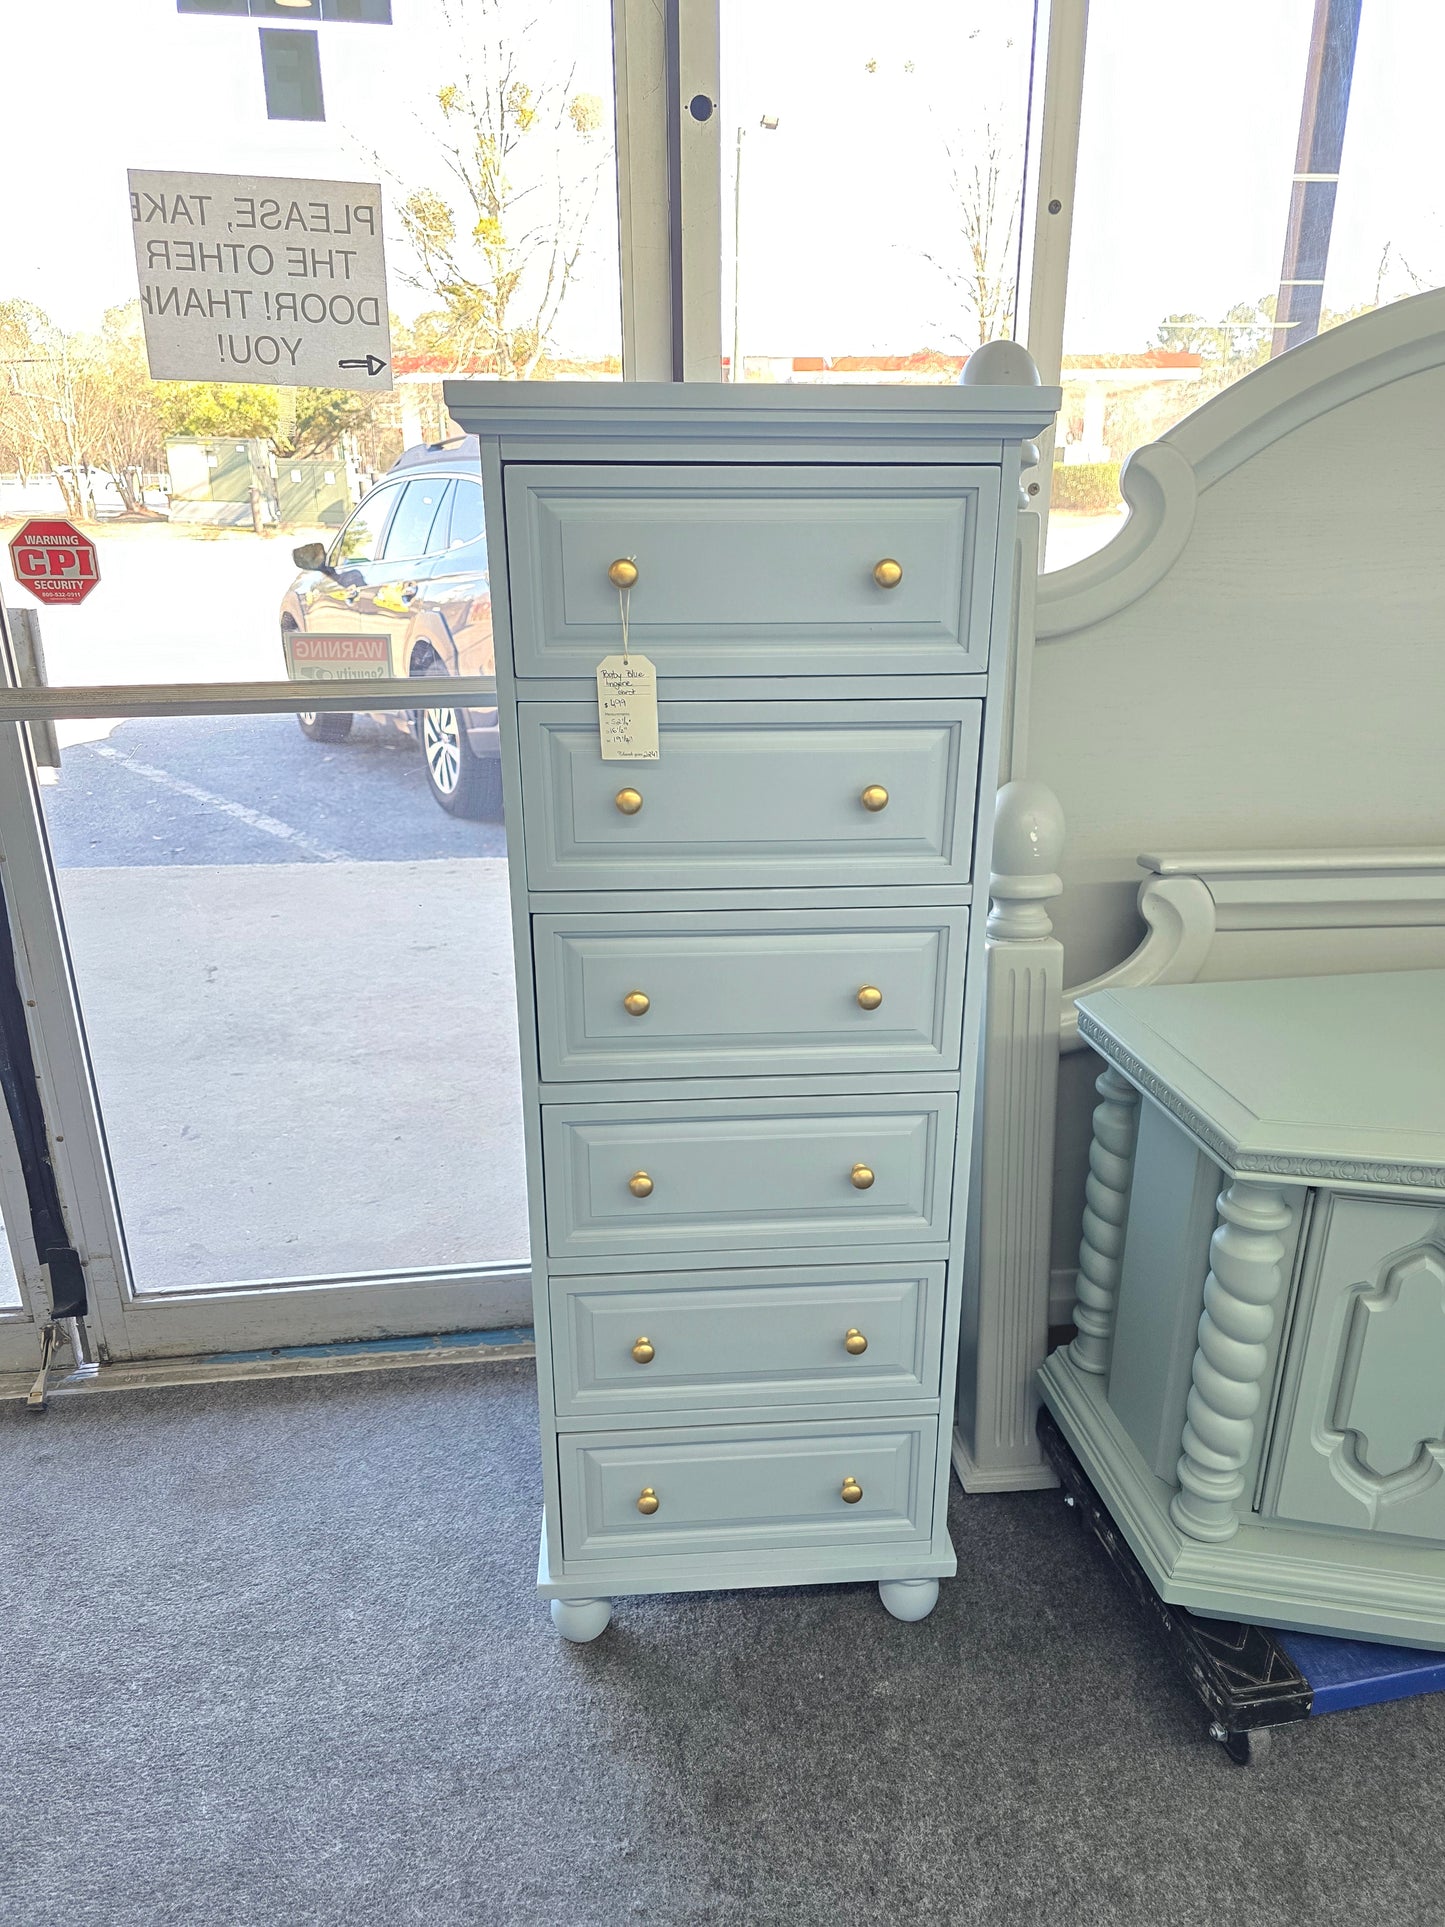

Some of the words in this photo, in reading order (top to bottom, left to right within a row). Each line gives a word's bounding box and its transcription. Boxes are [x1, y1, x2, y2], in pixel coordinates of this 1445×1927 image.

[24, 535, 79, 545] WARNING
[17, 548, 94, 577] CPI
[34, 580, 84, 590] SECURITY
